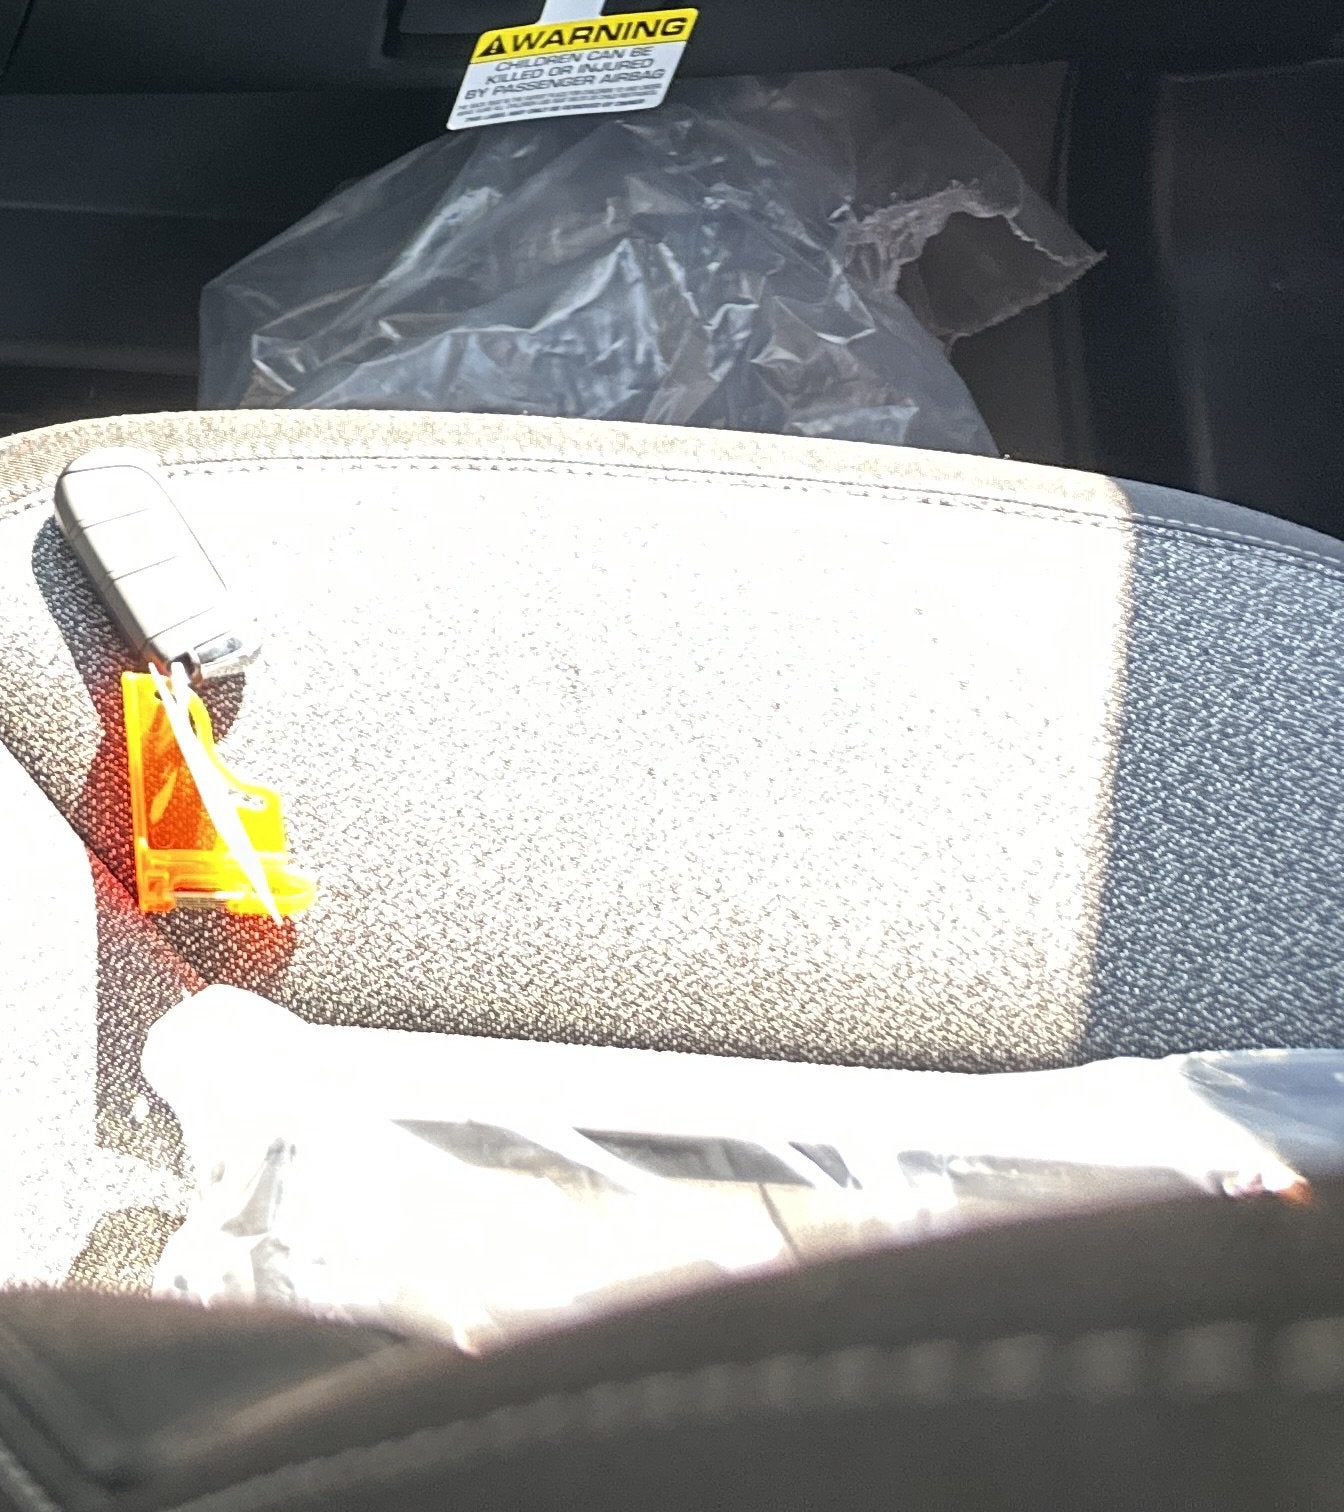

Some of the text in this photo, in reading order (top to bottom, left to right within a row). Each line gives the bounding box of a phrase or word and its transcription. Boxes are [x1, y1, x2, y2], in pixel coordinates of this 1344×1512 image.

[512, 17, 689, 52] WARNING
[485, 58, 655, 85] KILLED OR INJURED
[495, 46, 655, 72] CHILDREN CAN BE
[464, 69, 666, 100] BY PASSENGER AIRBAG
